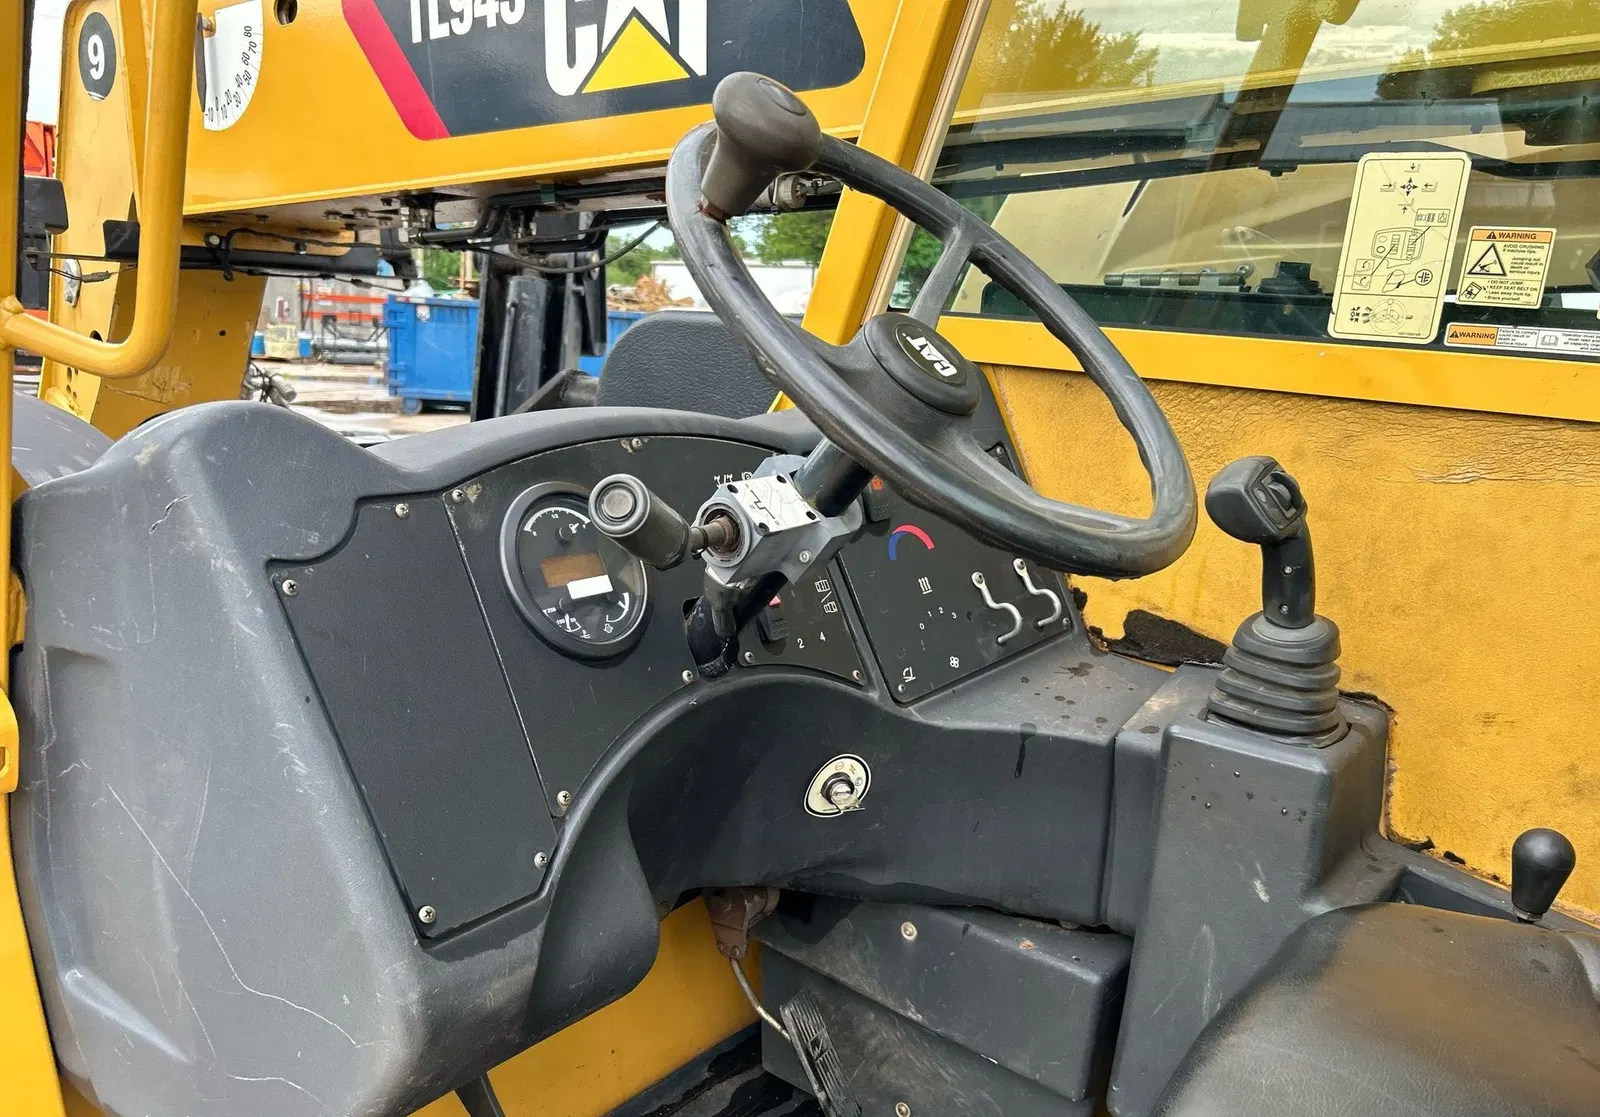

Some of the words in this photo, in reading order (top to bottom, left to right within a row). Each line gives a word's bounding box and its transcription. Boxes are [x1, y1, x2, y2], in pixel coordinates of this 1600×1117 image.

[243, 25, 252, 38] 80
[248, 41, 257, 54] 70
[87, 34, 105, 80] 9
[241, 52, 251, 66] 60
[242, 70, 252, 86] 50
[1498, 231, 1537, 240] WARNING
[1459, 331, 1496, 340] WARNING
[905, 336, 958, 377] CAT
[919, 622, 925, 630] 0
[927, 610, 932, 618] 1
[938, 606, 944, 614] 2
[797, 638, 804, 648] 2
[819, 631, 826, 642] 4
